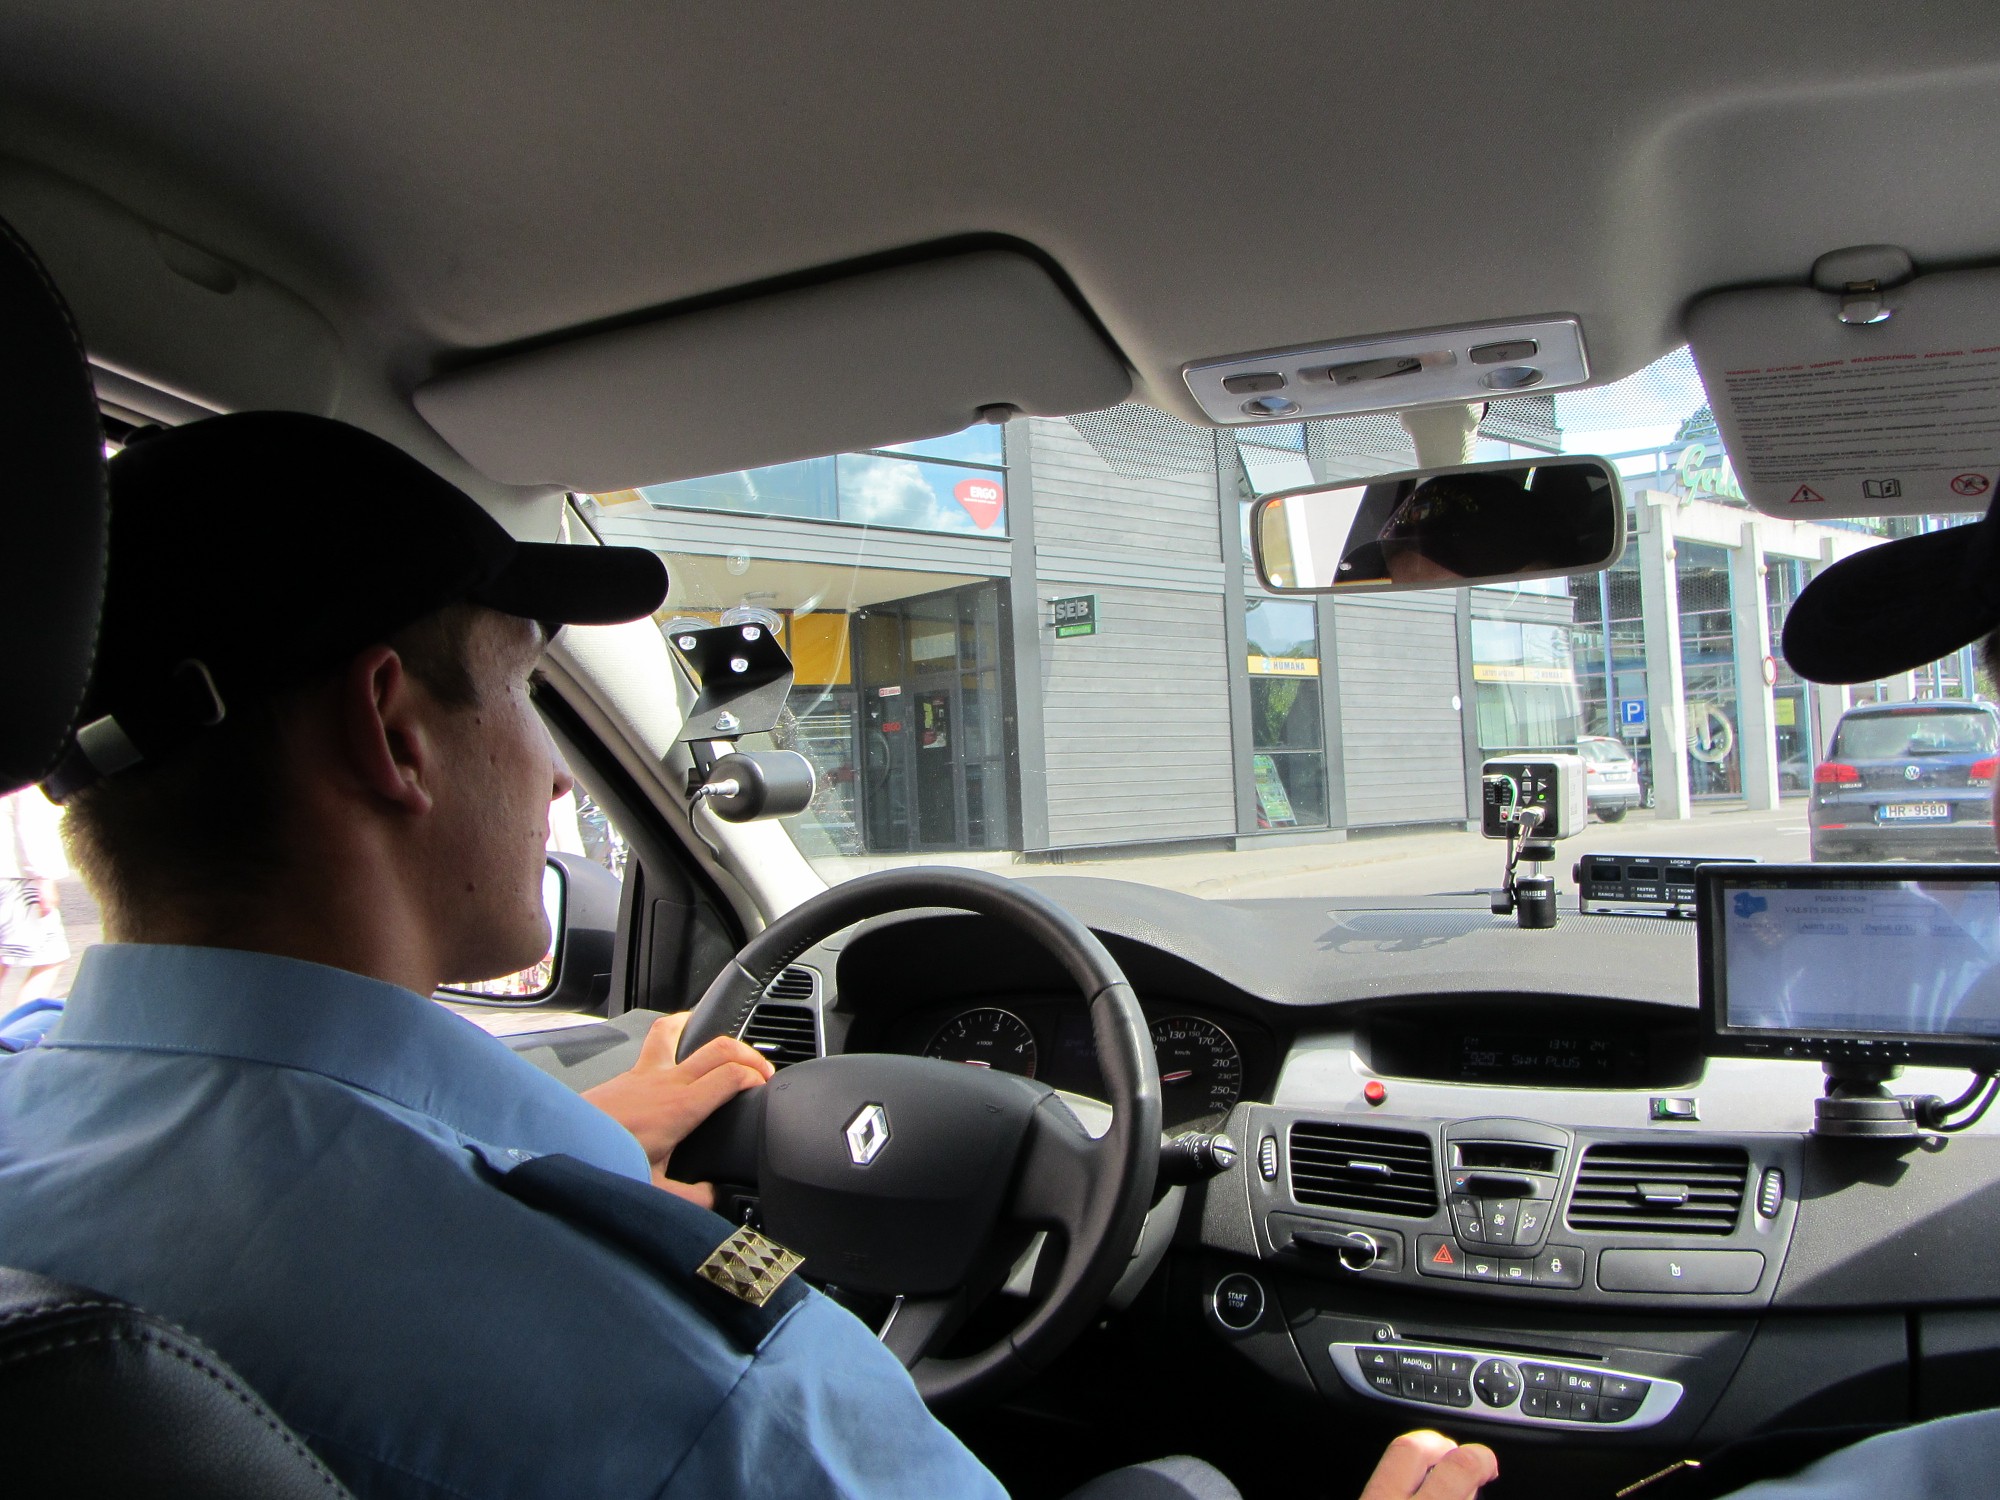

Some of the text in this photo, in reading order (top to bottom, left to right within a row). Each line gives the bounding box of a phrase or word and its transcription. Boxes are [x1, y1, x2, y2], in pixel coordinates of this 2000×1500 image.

[970, 486, 997, 500] ERGO
[1055, 601, 1088, 620] SEB
[1273, 661, 1305, 671] HUMANA
[1627, 703, 1640, 721] P
[1888, 805, 1945, 816] HR-9580
[992, 1023, 1000, 1032] 3
[959, 1030, 966, 1038] 2
[1169, 1031, 1186, 1040] 130
[1198, 1037, 1214, 1046] 170
[1015, 1043, 1023, 1053] 4
[1212, 1058, 1230, 1067] 210
[1210, 1086, 1230, 1094] 250
[1209, 1101, 1223, 1109] 270
[1228, 1291, 1248, 1301] START
[1228, 1299, 1244, 1308] STOP
[1402, 1356, 1432, 1371] RADIO/CD
[1433, 1385, 1438, 1393] 2
[1457, 1388, 1462, 1397] 3
[1531, 1398, 1537, 1406] 4
[1555, 1400, 1561, 1409] 5
[1580, 1402, 1586, 1411] 6
